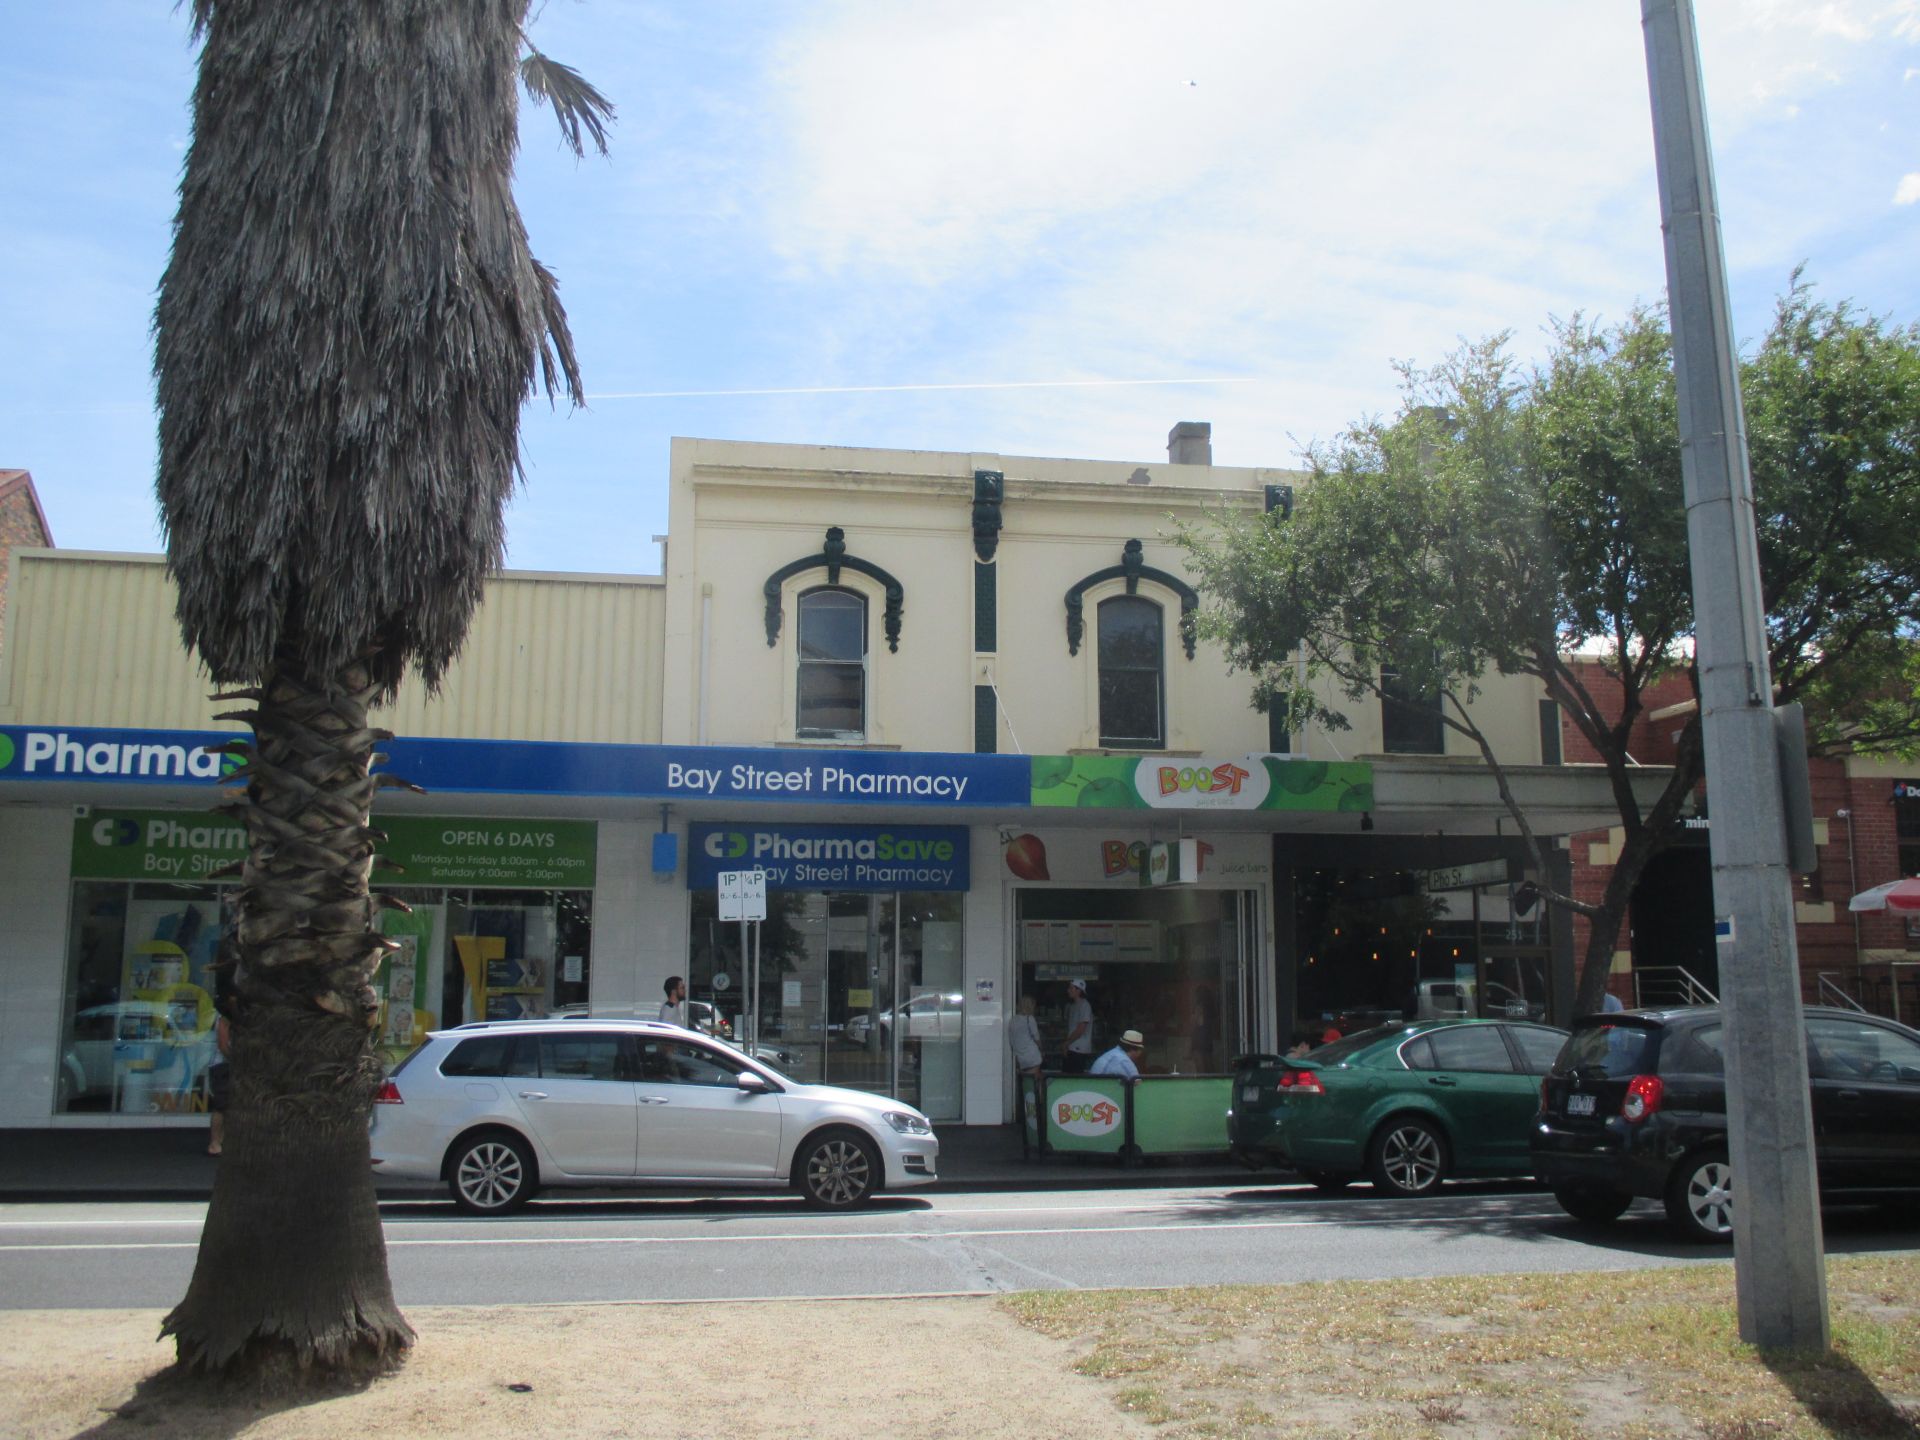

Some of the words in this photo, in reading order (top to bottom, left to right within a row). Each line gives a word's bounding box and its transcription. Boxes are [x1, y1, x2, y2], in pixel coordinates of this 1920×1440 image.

[668, 763, 722, 794] Bay
[731, 765, 813, 791] Street
[822, 767, 968, 800] Pharmacy
[1158, 763, 1250, 797] BOOST
[442, 831, 489, 846] OPEN
[493, 831, 504, 846] 6
[509, 832, 555, 848] DAYS
[754, 832, 954, 861] PharmaSave
[144, 853, 185, 875] Bay
[411, 854, 453, 866] Monday
[455, 854, 466, 865] to
[468, 855, 498, 867] Friday
[1220, 862, 1245, 875] juice
[1246, 862, 1268, 873] bars
[431, 867, 475, 879] Saturday
[794, 864, 849, 882] Street
[855, 865, 953, 886] Pharmacy
[1058, 1101, 1118, 1125] BOOST
